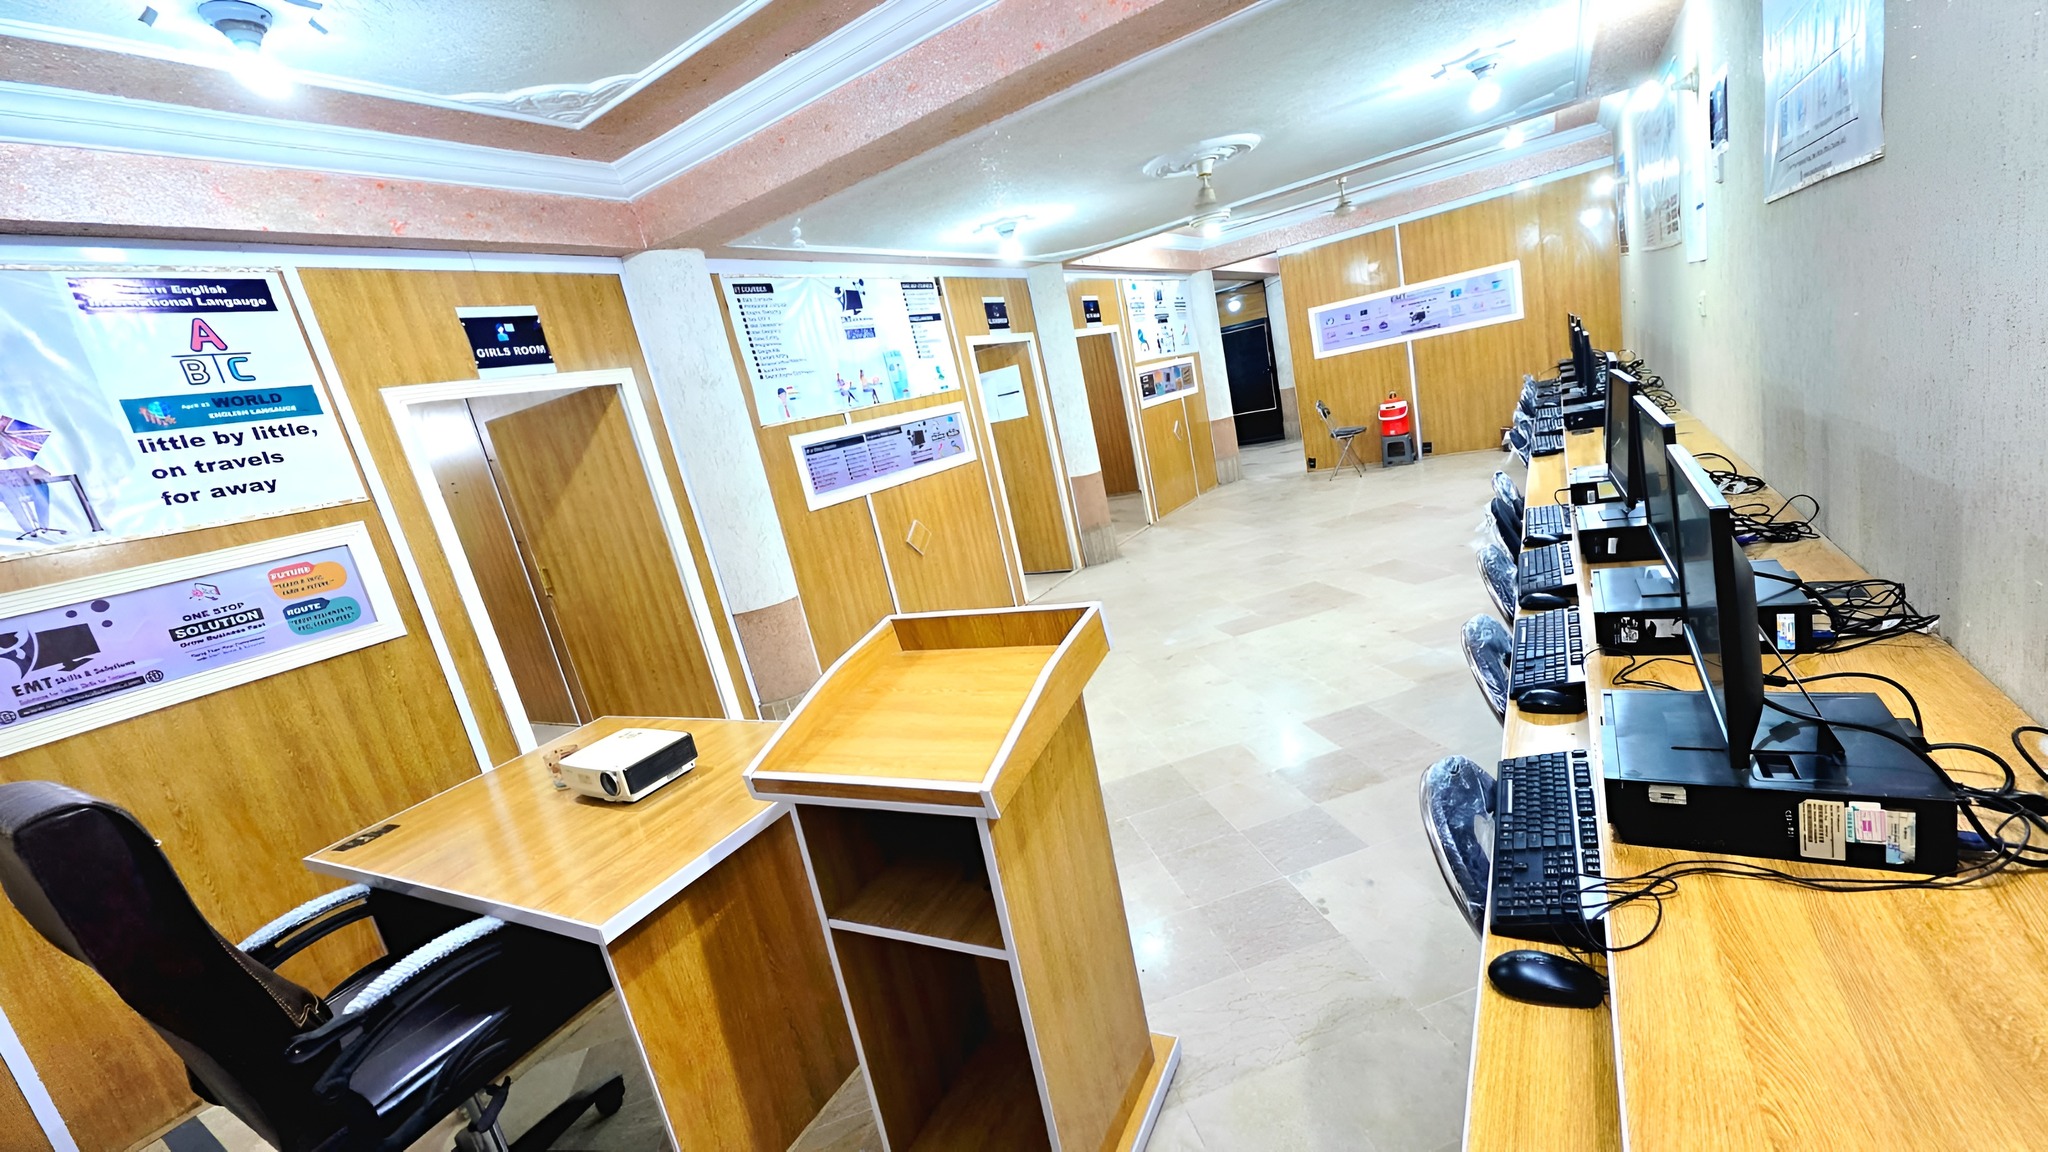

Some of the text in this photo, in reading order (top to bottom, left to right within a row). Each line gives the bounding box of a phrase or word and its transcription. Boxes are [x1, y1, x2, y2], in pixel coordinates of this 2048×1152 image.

[170, 285, 227, 296] English
[190, 318, 228, 352] A
[476, 345, 546, 358] GIRLS ROOM
[180, 357, 256, 385] B C
[211, 393, 282, 408] WORLD
[137, 423, 318, 453] little by little,
[152, 451, 284, 479] on travels
[161, 479, 277, 506] for away
[182, 602, 244, 621] ONE STOP
[287, 603, 321, 616] ROUTE
[175, 610, 259, 638] SOLUTION
[11, 677, 53, 697] EMT
[55, 673, 82, 685] Skills
